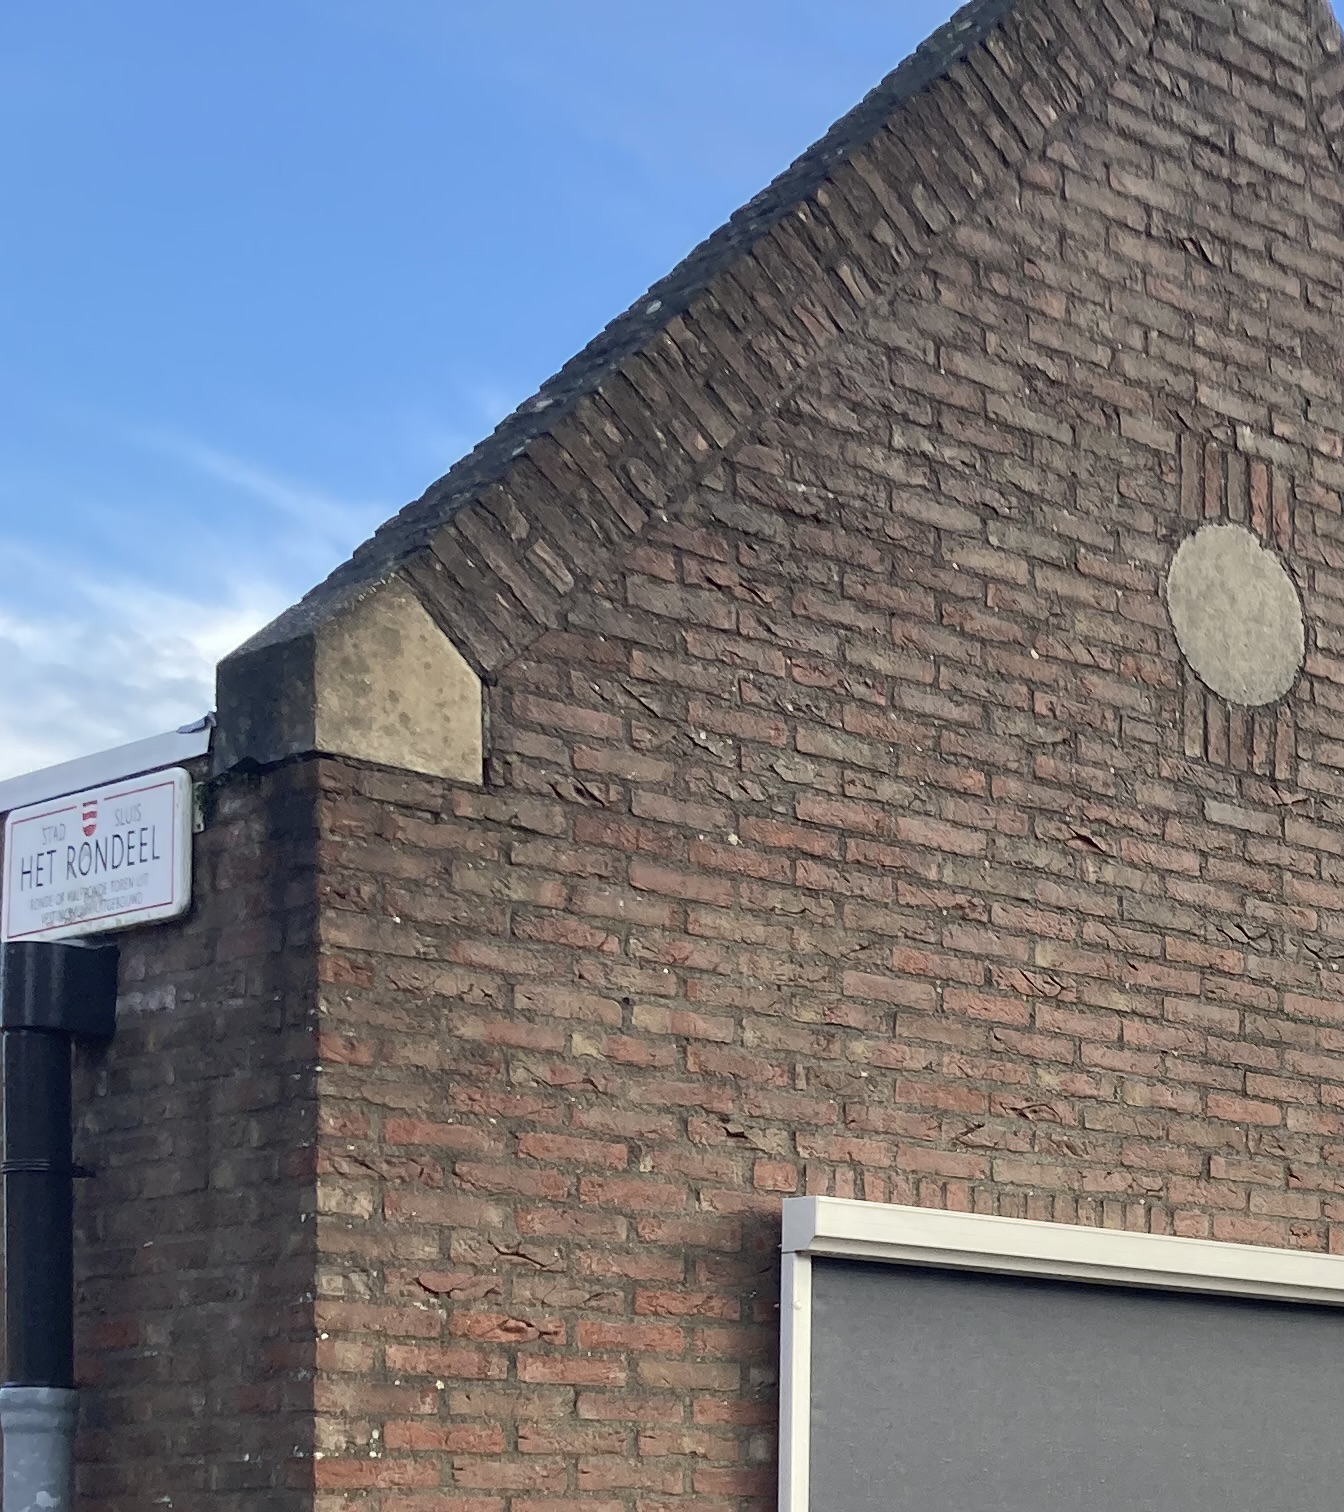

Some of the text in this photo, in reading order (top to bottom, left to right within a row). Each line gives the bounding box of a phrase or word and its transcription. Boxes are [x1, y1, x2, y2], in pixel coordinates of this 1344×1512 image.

[41, 803, 142, 846] STAD SLUIS
[20, 824, 160, 892] HET RONDEEL
